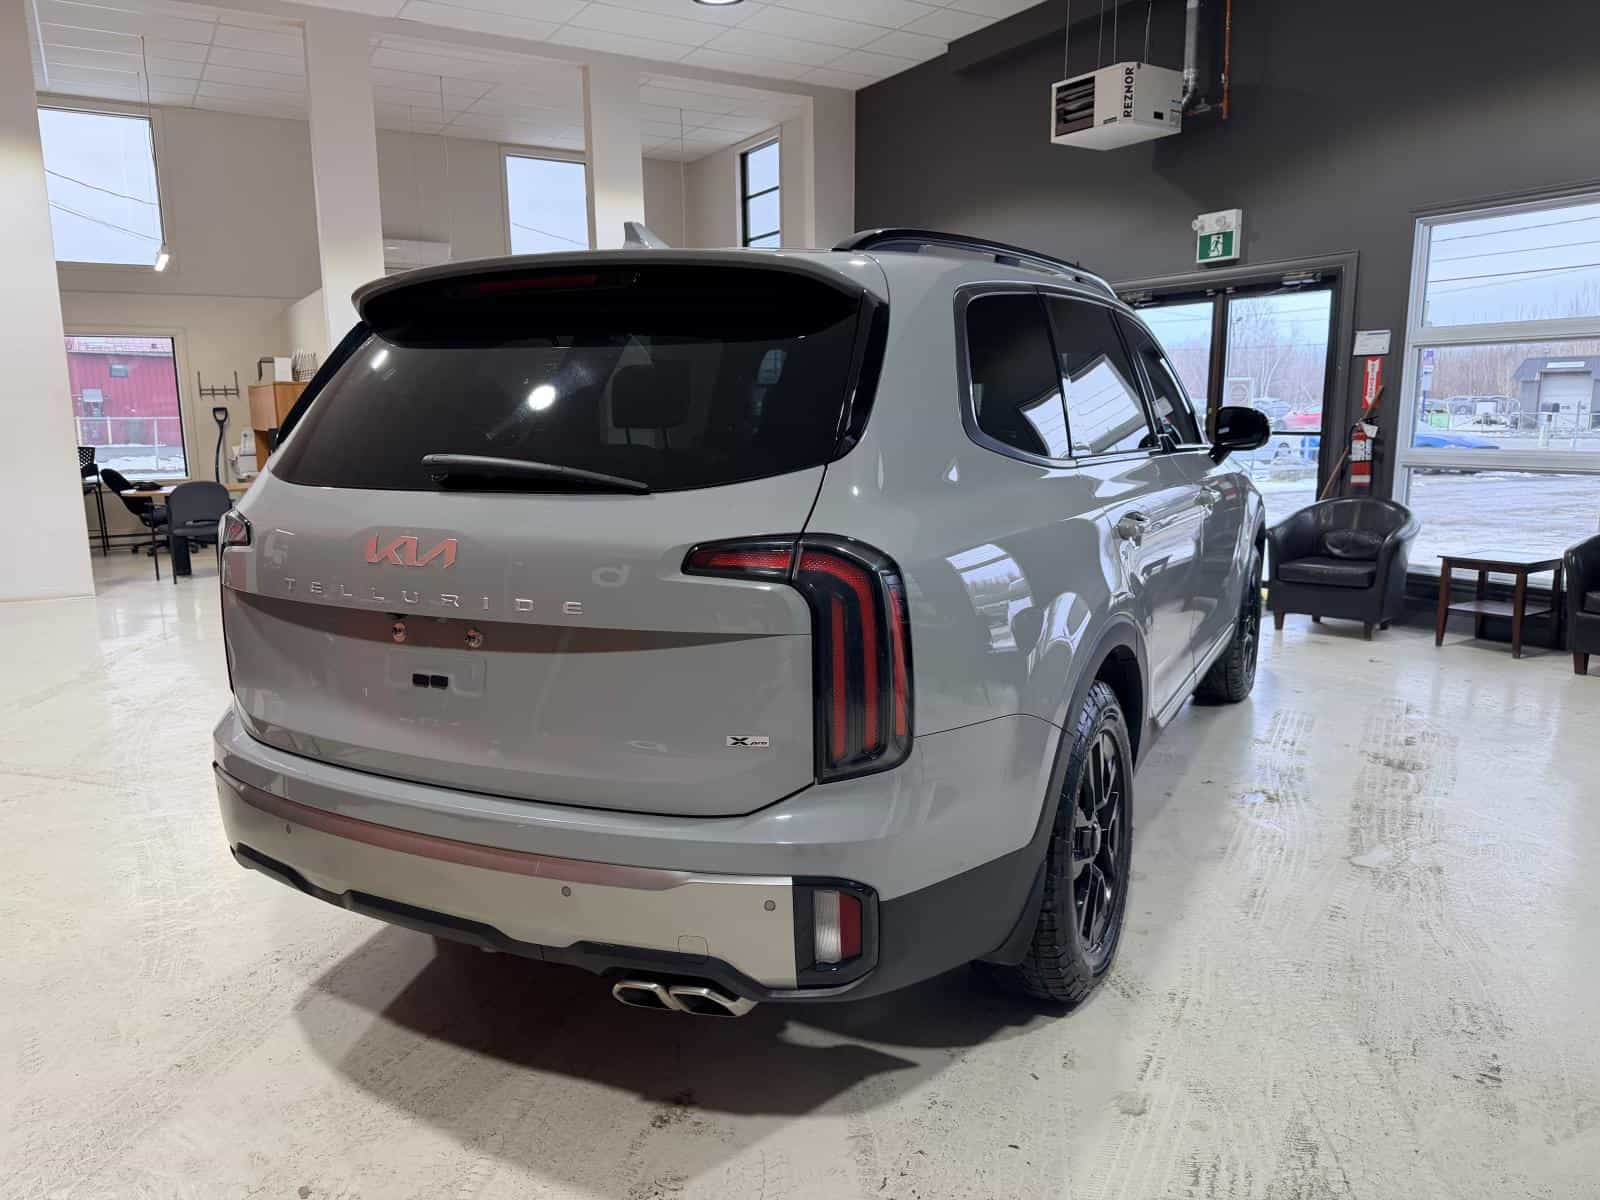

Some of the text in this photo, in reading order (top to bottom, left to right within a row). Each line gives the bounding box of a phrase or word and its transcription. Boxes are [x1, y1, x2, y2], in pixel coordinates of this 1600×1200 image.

[1122, 66, 1135, 118] REZNOR
[364, 536, 458, 569] KIA
[285, 577, 583, 615] TELLURIDE
